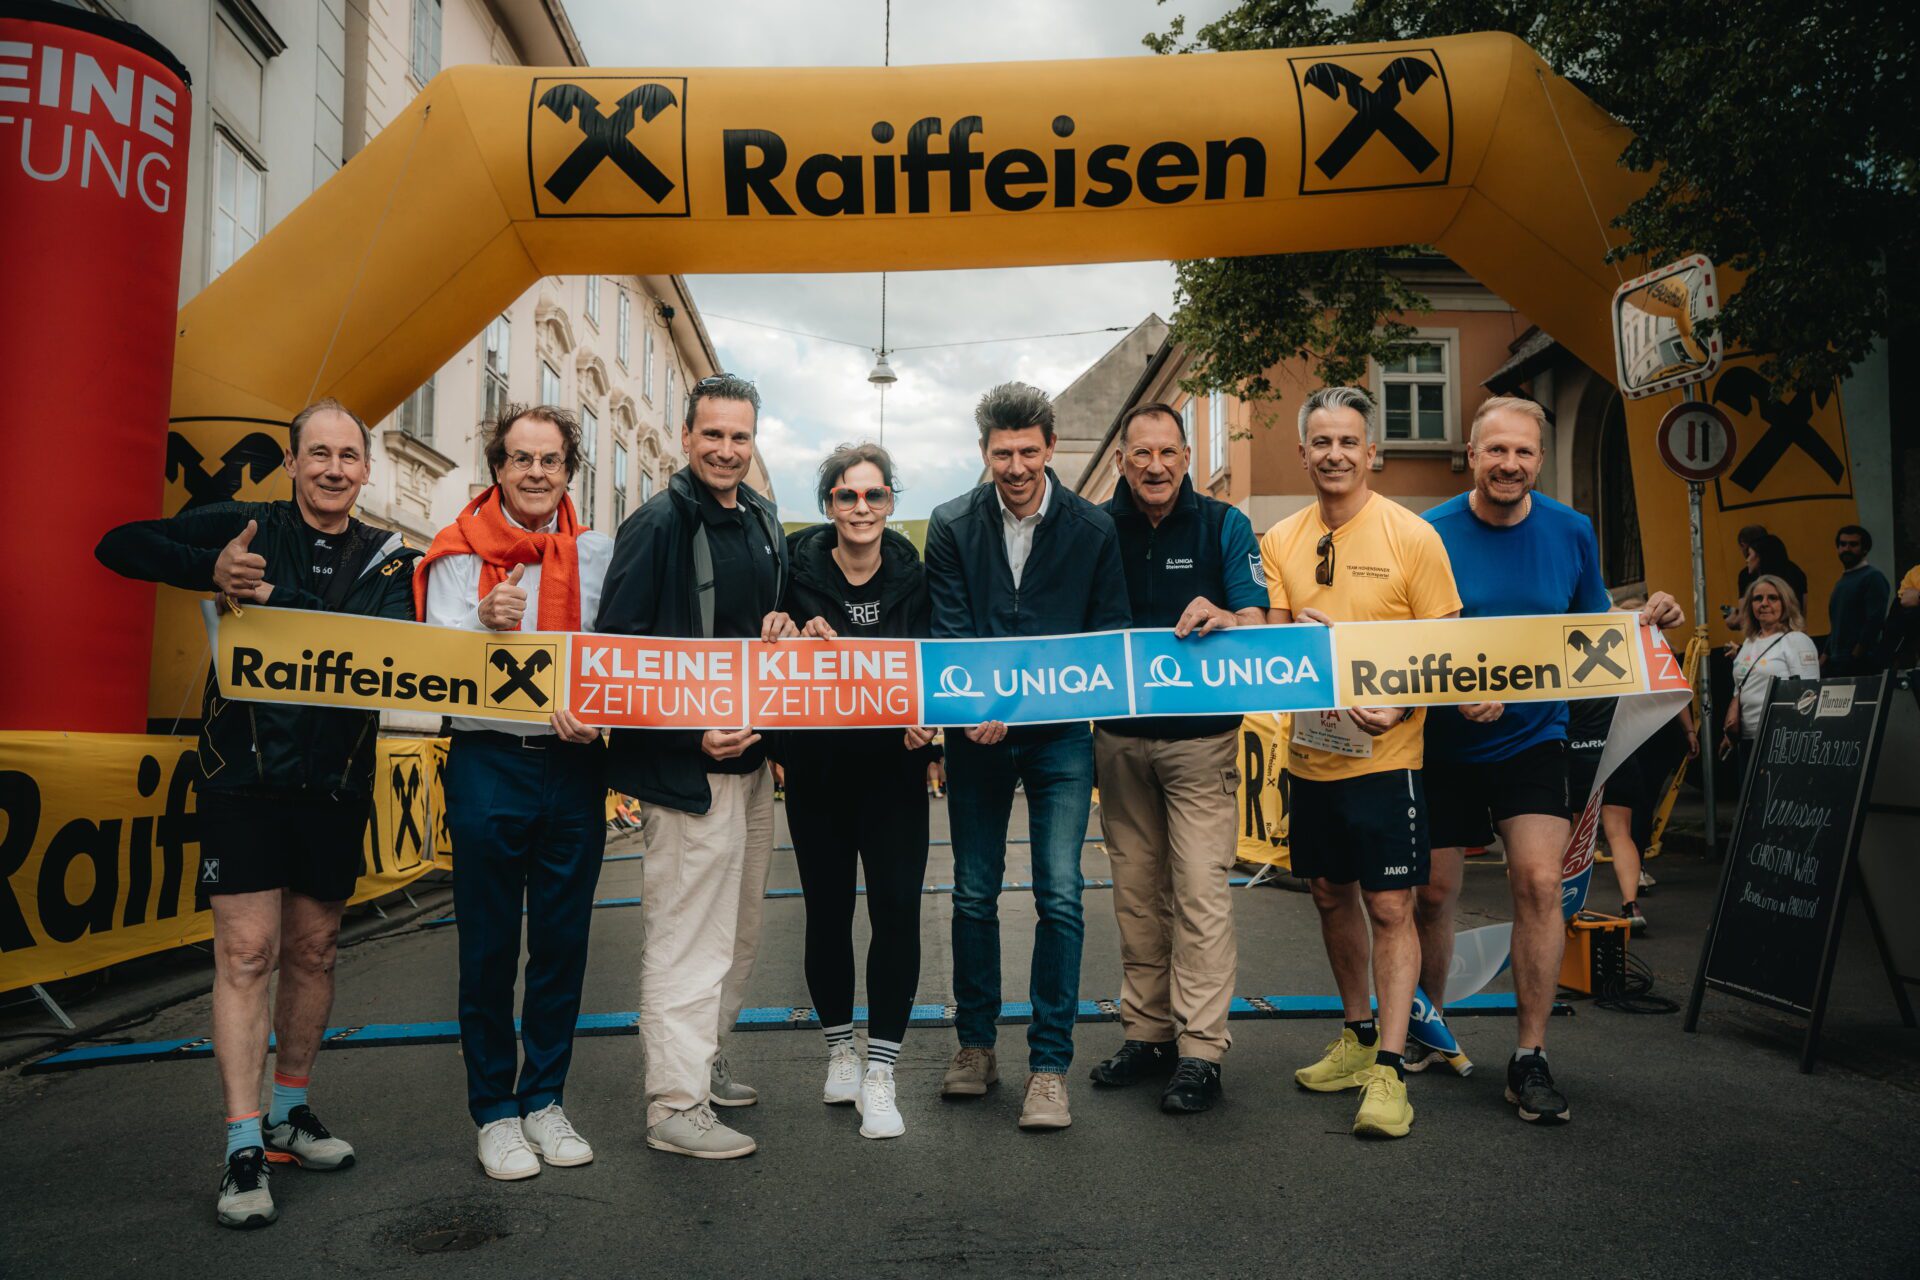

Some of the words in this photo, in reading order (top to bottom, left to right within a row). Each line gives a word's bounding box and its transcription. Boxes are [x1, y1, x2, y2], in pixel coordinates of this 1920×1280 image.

[722, 115, 1267, 216] Raiffeisen
[231, 646, 478, 705] Raiffeisen
[581, 647, 733, 681] KLEINE
[758, 650, 908, 680] KLEINE
[993, 664, 1114, 697] UNIQA
[1201, 655, 1320, 687] UNIQA
[1351, 652, 1561, 696] Raiffeisen
[578, 683, 734, 716] ZEITUNG
[758, 685, 909, 716] ZEITUNG
[1321, 720, 1337, 729] Kurt
[1266, 743, 1278, 777] Raiffeisen
[1571, 739, 1607, 749] GARM
[1768, 726, 1822, 765] HEUTE
[1384, 866, 1408, 875] JAKO
[1750, 842, 1795, 875] CHRISTIAN
